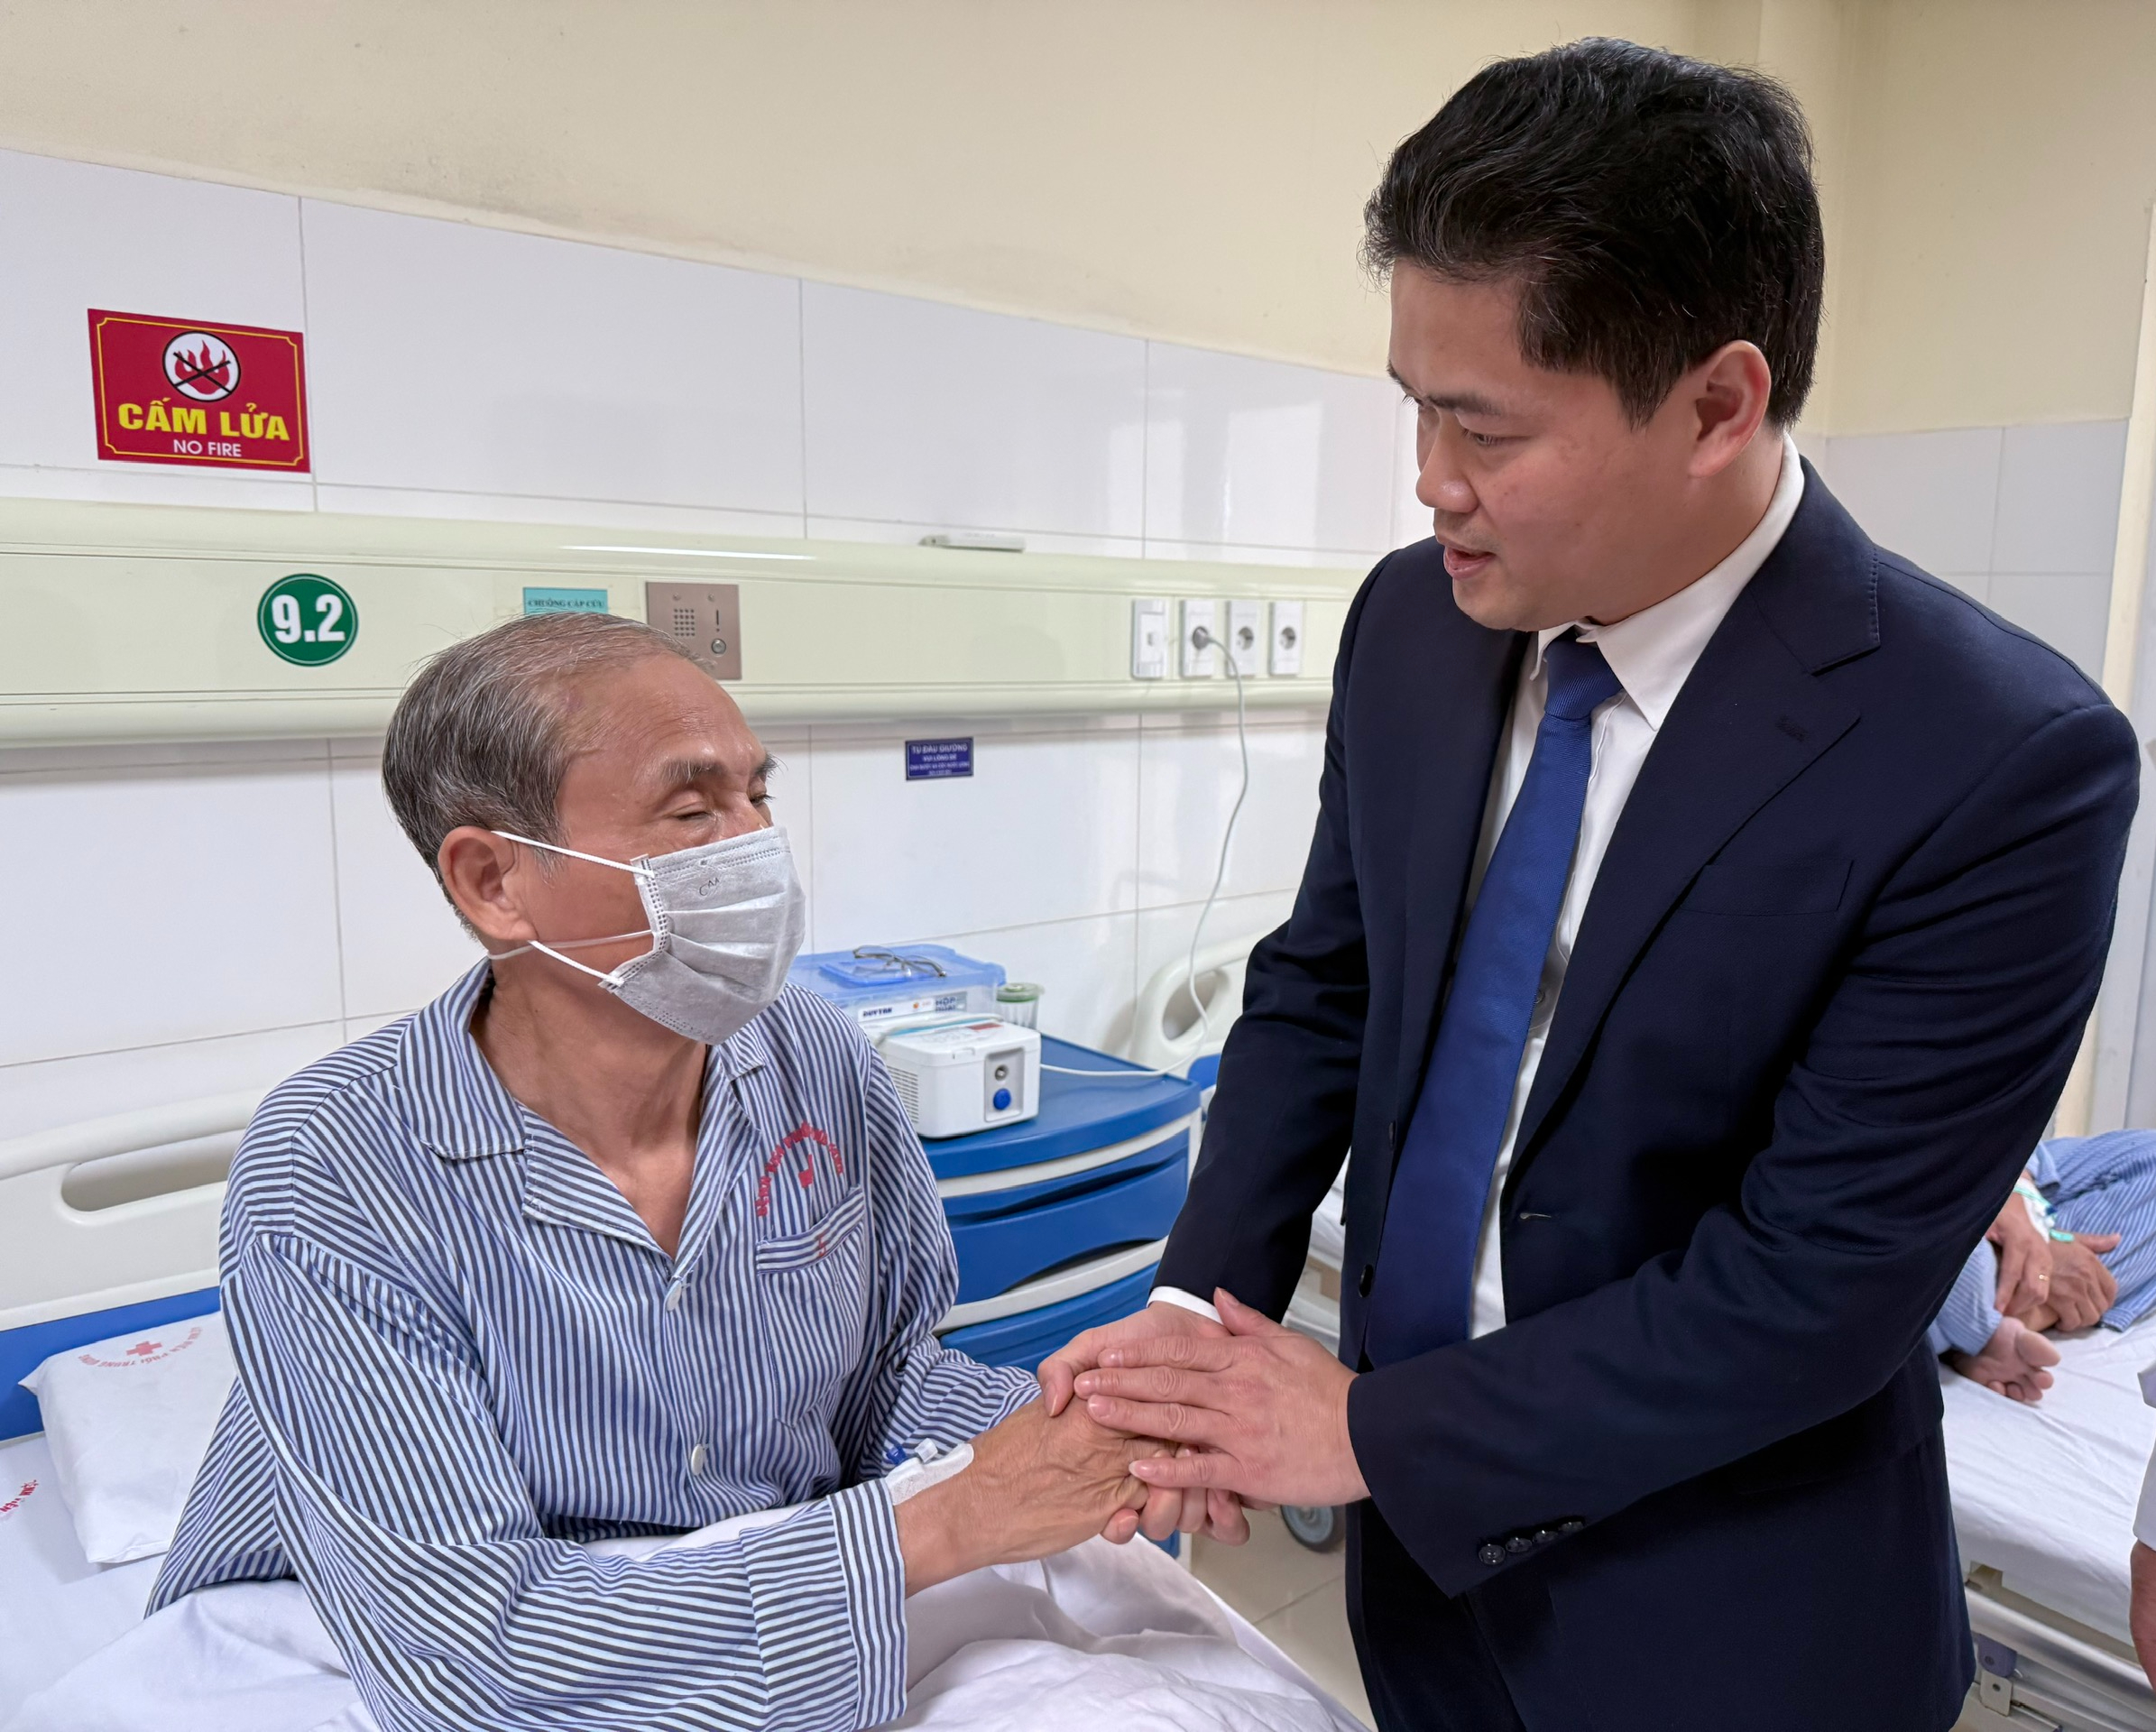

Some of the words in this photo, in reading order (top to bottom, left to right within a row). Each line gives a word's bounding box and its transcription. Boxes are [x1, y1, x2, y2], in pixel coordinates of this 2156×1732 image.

[118, 397, 207, 435] CẤM
[220, 402, 290, 440] LỬA
[173, 439, 202, 455] NO
[207, 441, 242, 457] FIRE
[272, 594, 346, 644] 9.2
